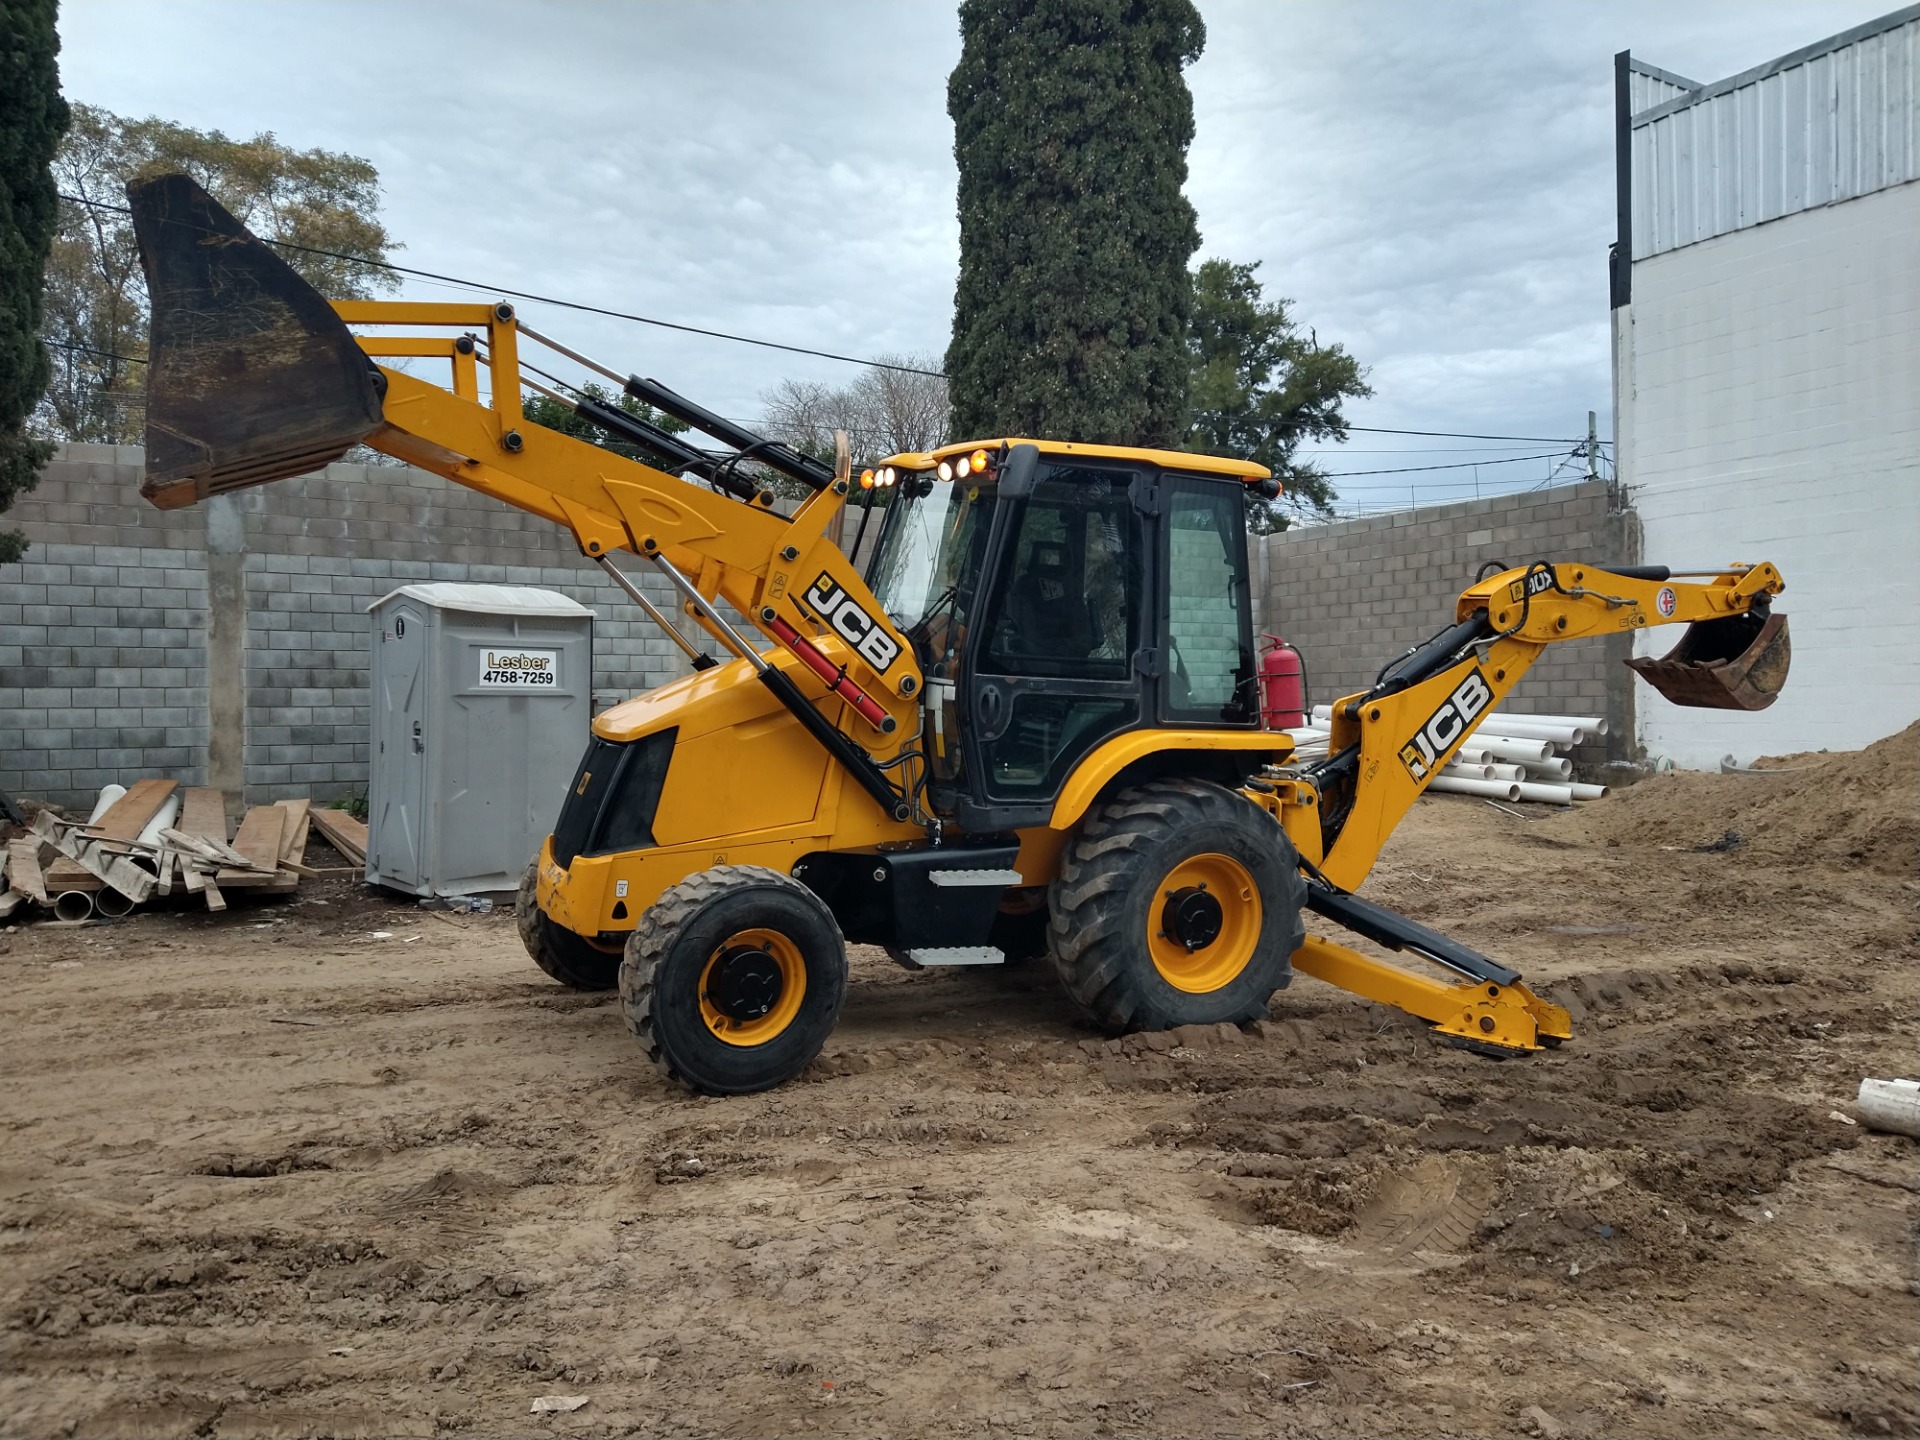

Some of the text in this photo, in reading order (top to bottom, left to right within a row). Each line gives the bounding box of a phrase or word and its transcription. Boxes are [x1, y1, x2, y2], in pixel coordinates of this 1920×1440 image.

[808, 586, 898, 671] JCB
[483, 670, 553, 684] 4758-7259
[488, 652, 550, 670] Lesber
[1410, 674, 1490, 777] JCB
